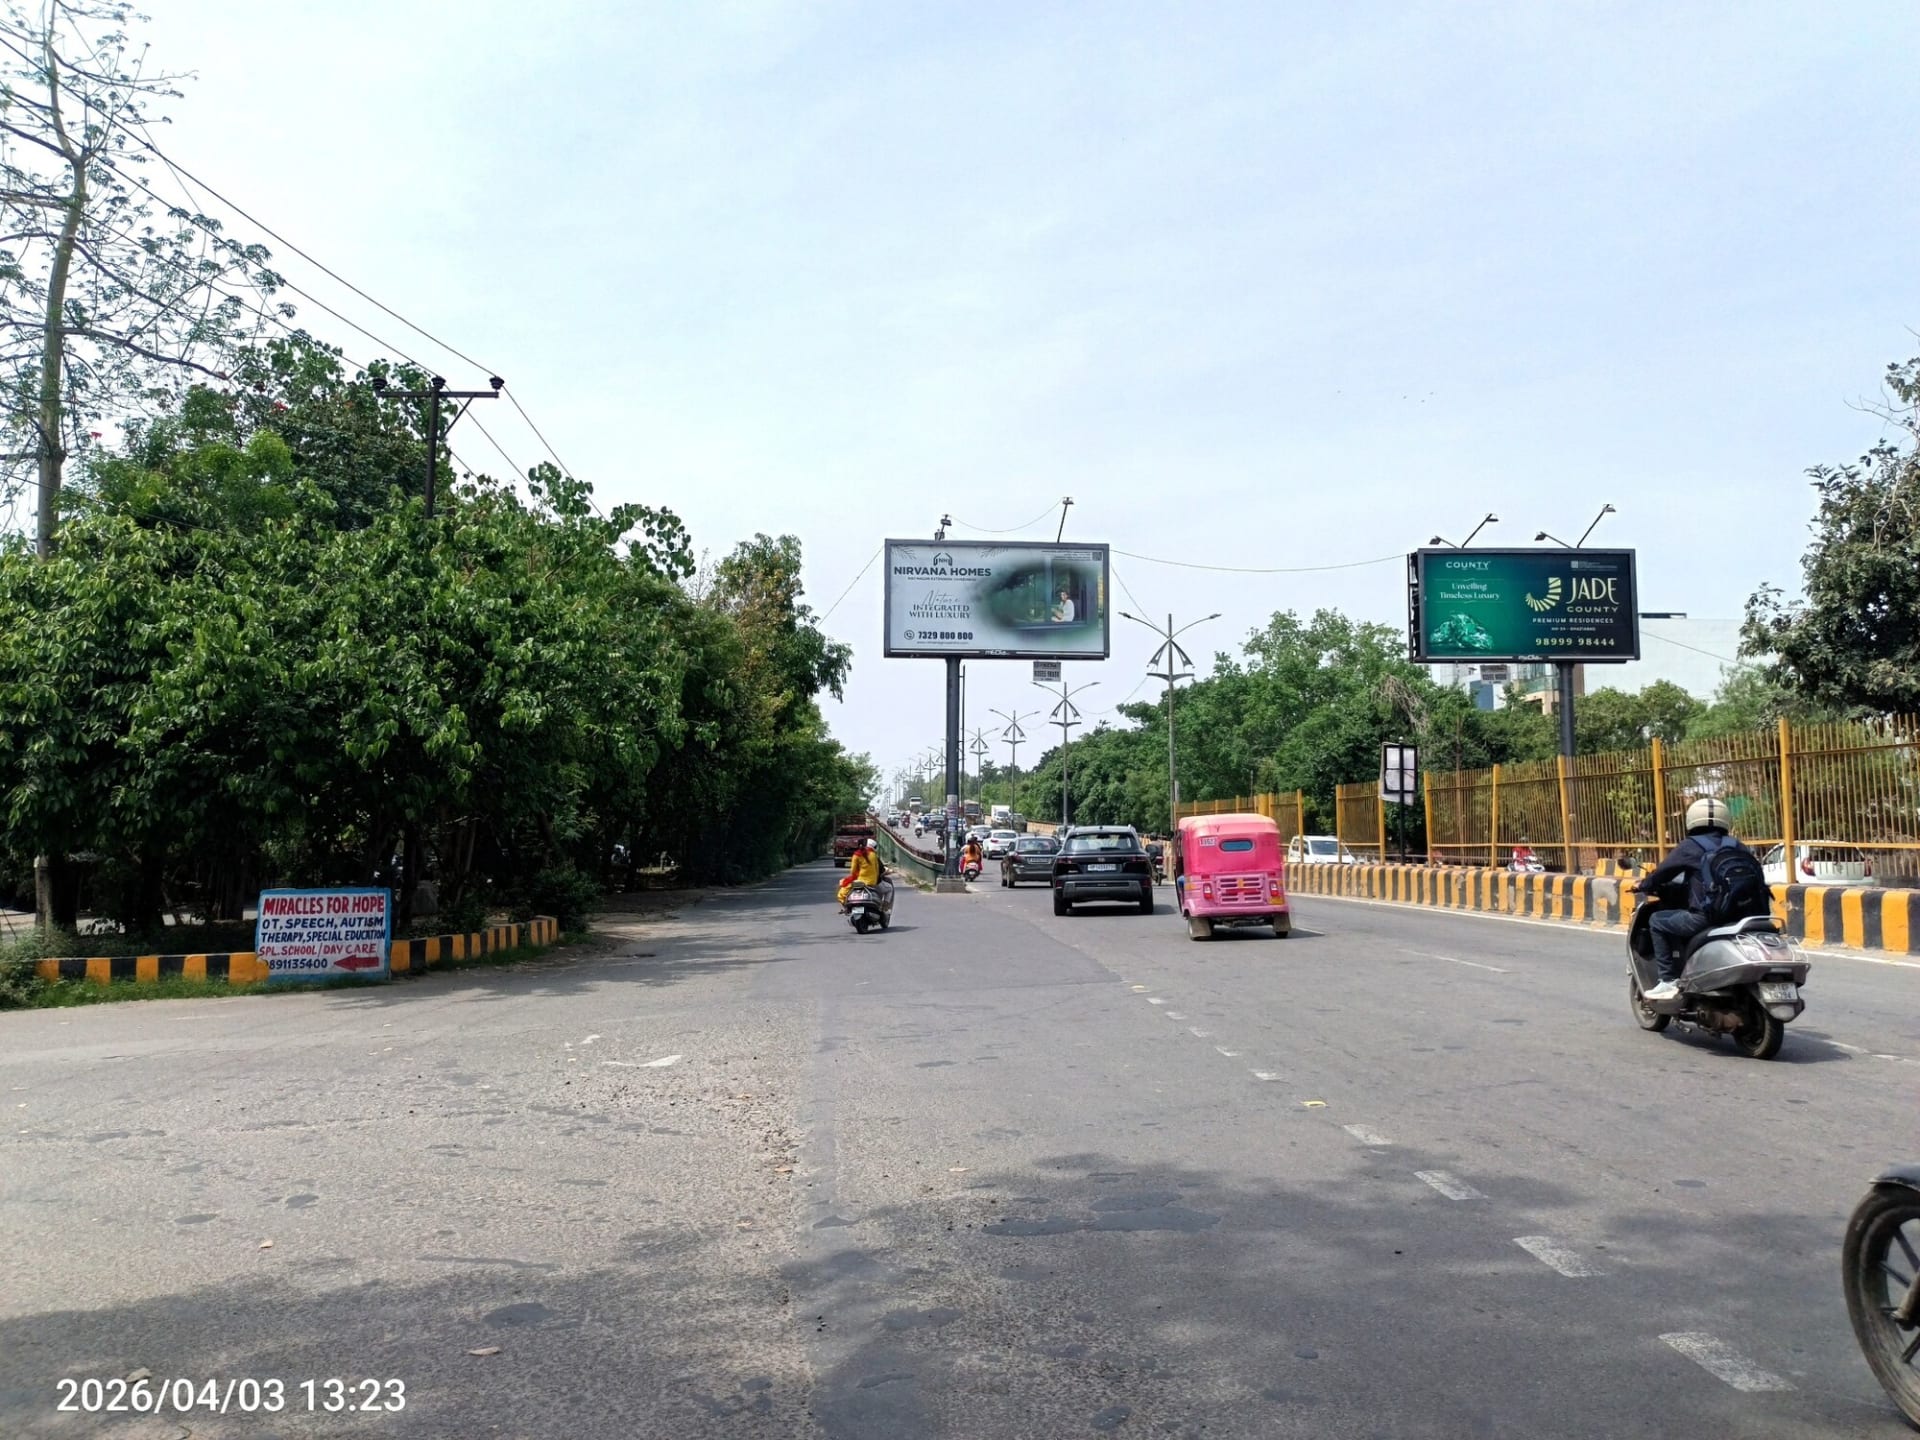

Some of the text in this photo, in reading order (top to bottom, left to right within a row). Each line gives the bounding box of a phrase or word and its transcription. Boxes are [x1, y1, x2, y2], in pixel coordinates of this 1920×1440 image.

[1445, 561, 1489, 569] COUNTY
[894, 566, 992, 577] NIRVANA HOMES
[1439, 591, 1473, 599] Timeless
[1565, 577, 1620, 605] JADE
[913, 603, 970, 612] INTEGRATED
[935, 611, 971, 619] LUXURY
[918, 631, 938, 640] 7329
[1535, 638, 1615, 646] 98999 98444
[263, 895, 385, 916] MIRACLES FOR HOPE
[262, 916, 384, 931] OT, SPEECH, AUTISM
[344, 929, 386, 941] EDUCATION
[345, 943, 377, 953] CARE
